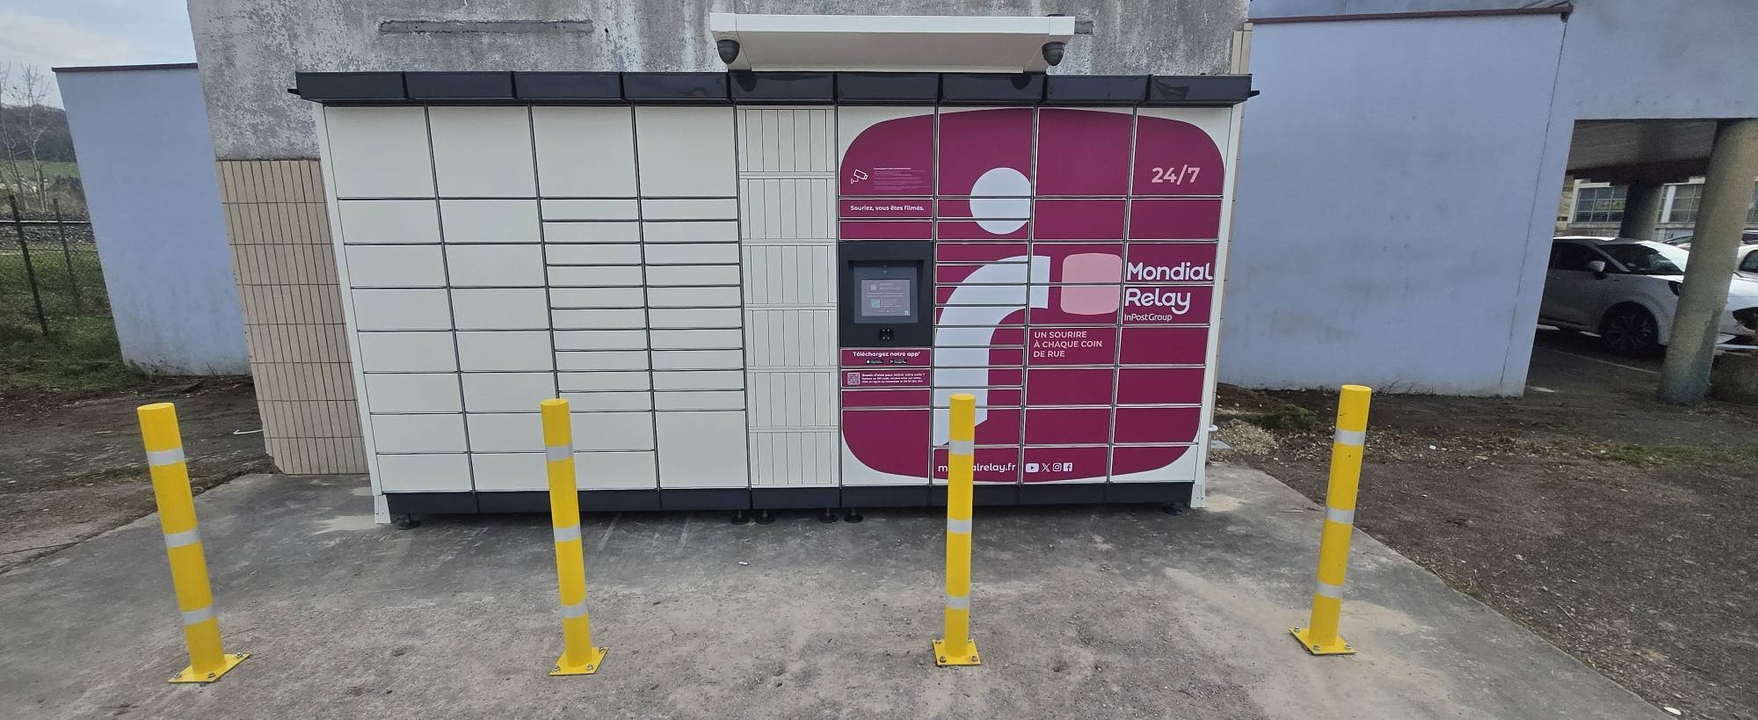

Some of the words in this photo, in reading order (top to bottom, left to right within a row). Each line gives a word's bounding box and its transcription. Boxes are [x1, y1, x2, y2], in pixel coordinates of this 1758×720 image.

[1151, 164, 1201, 185] 24/7
[1126, 261, 1214, 281] Mondial
[1124, 287, 1191, 315] Relay
[1034, 331, 1047, 339] UN
[1049, 330, 1088, 338] SOURIRE
[1033, 339, 1041, 348] À
[1042, 340, 1079, 349] CHAQUE
[1080, 340, 1103, 348] COIN
[1033, 350, 1046, 358] DE
[1047, 350, 1066, 358] RUE
[938, 462, 1016, 473] malrelay.fr
